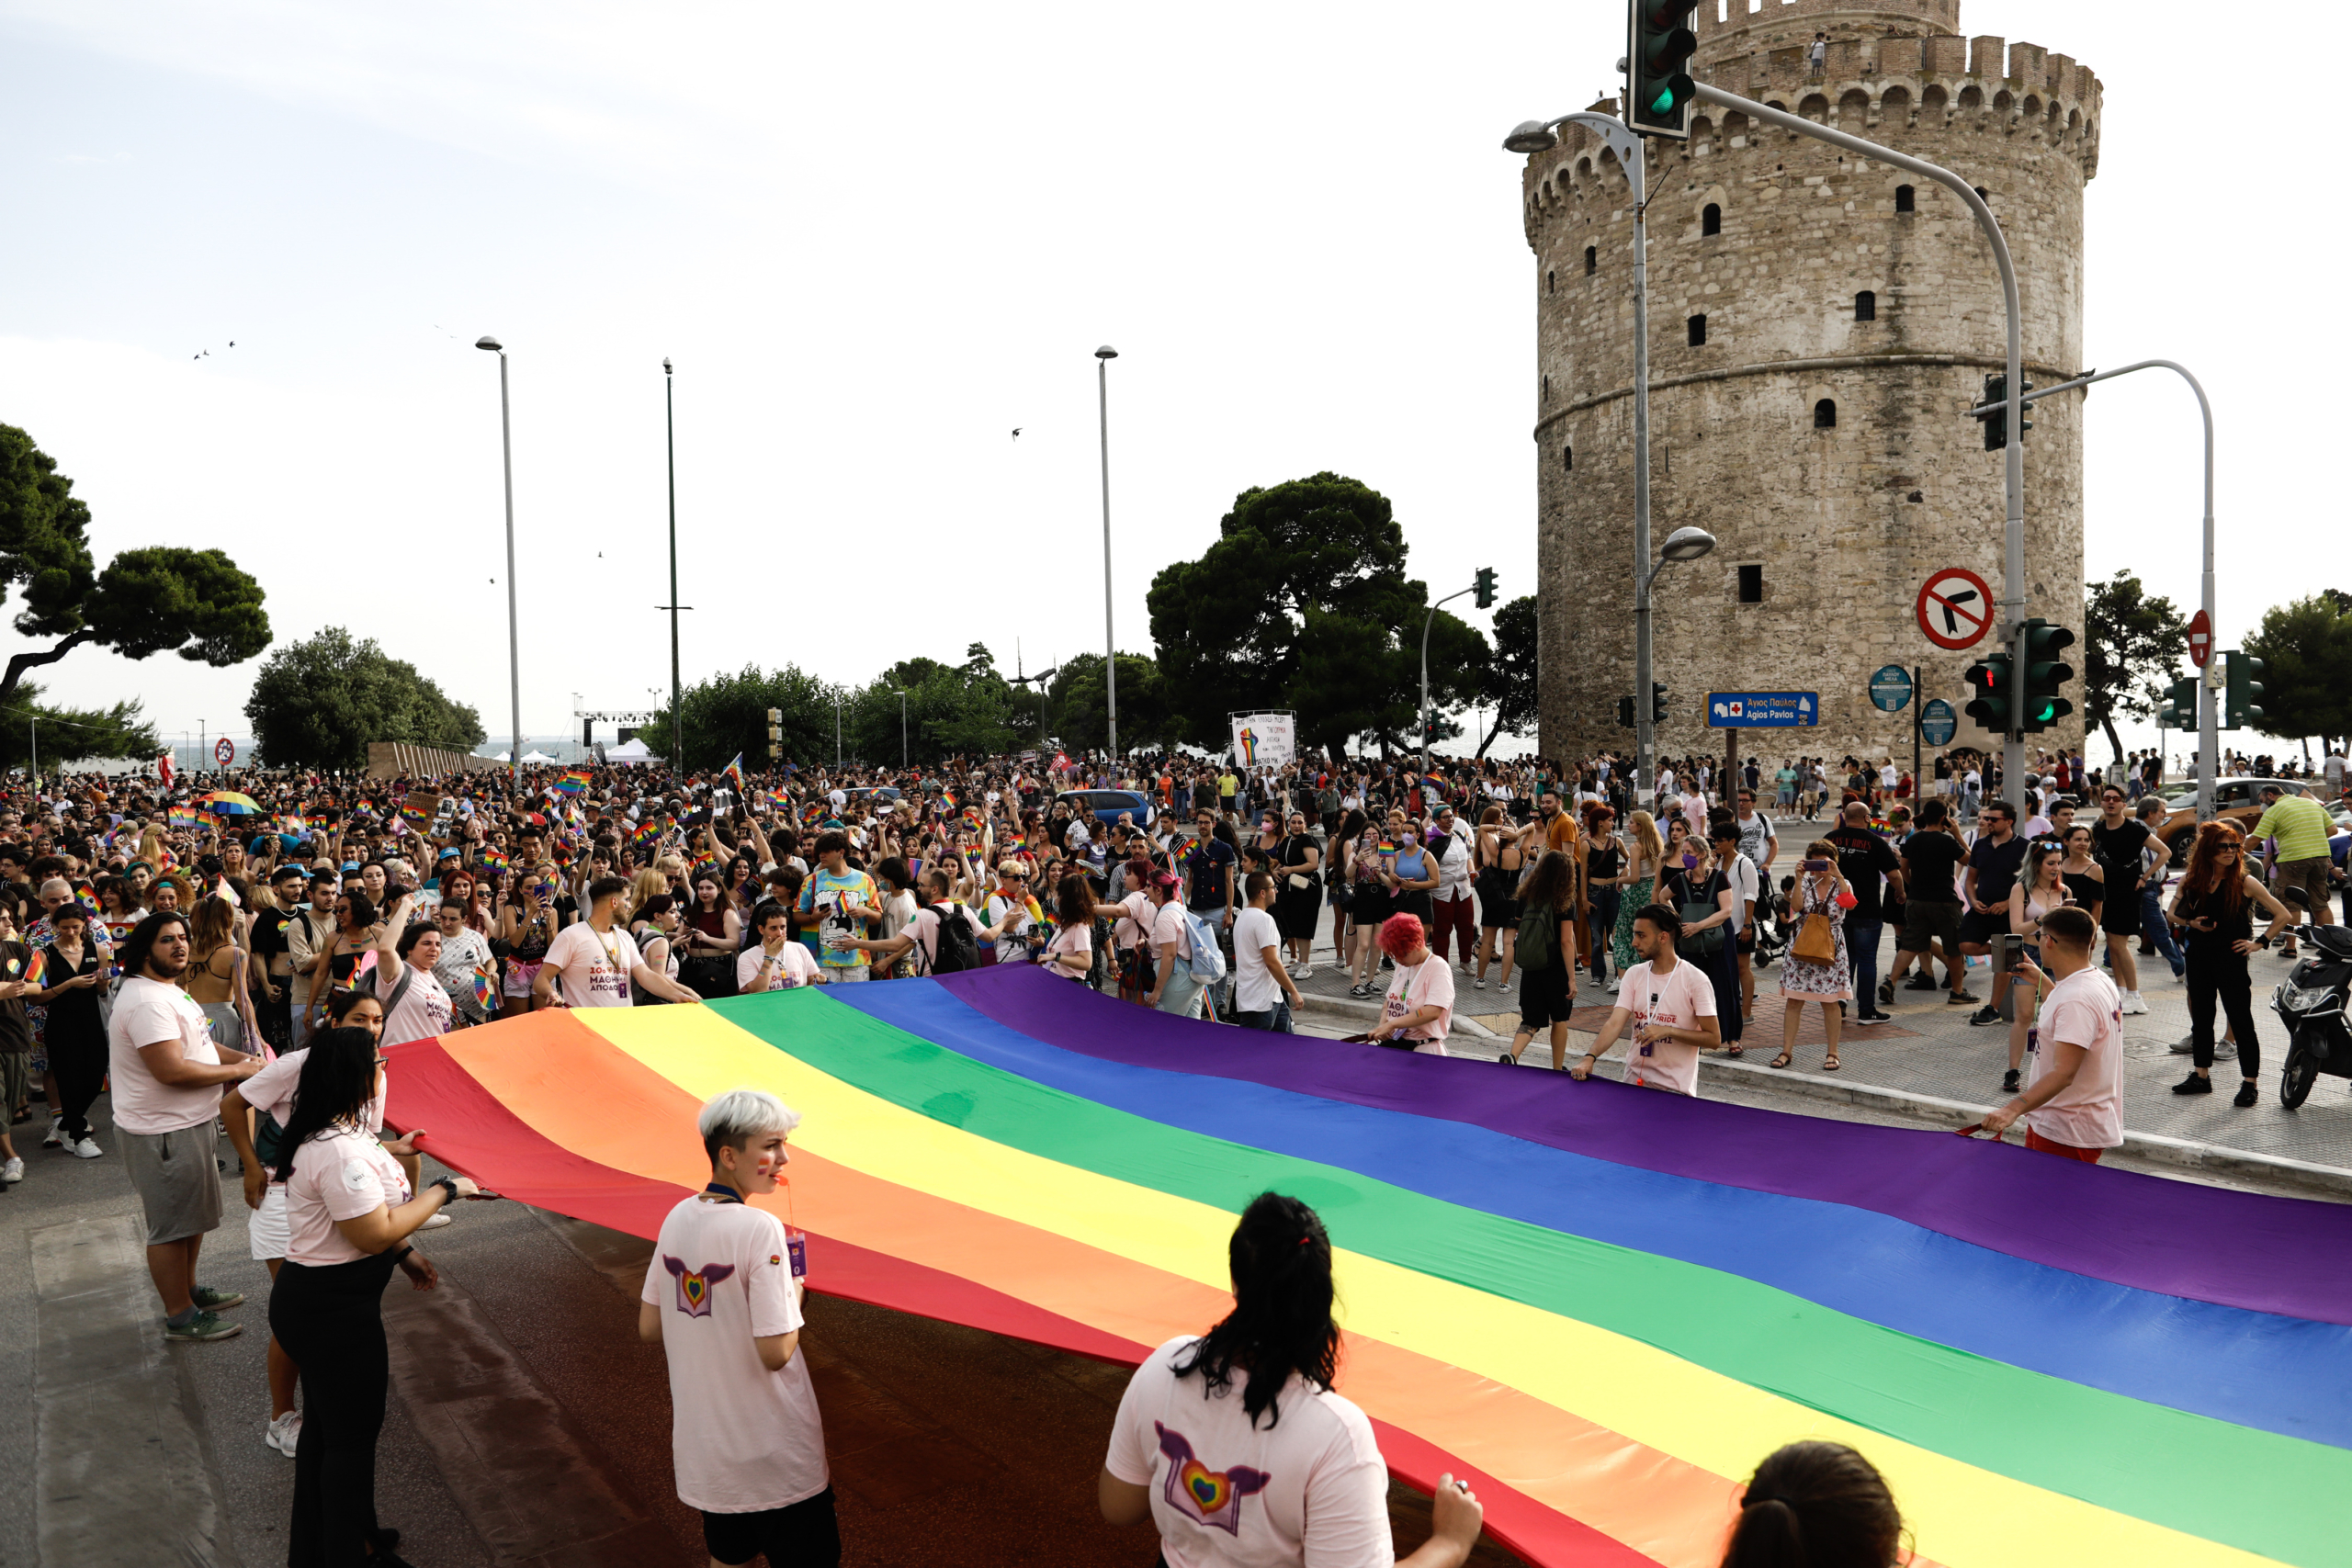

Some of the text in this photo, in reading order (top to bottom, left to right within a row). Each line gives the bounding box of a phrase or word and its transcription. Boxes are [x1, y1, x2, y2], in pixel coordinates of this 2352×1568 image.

[1747, 698, 1797, 708] Άγιος Παύλος
[1747, 710, 1793, 720] Agios Pavlos
